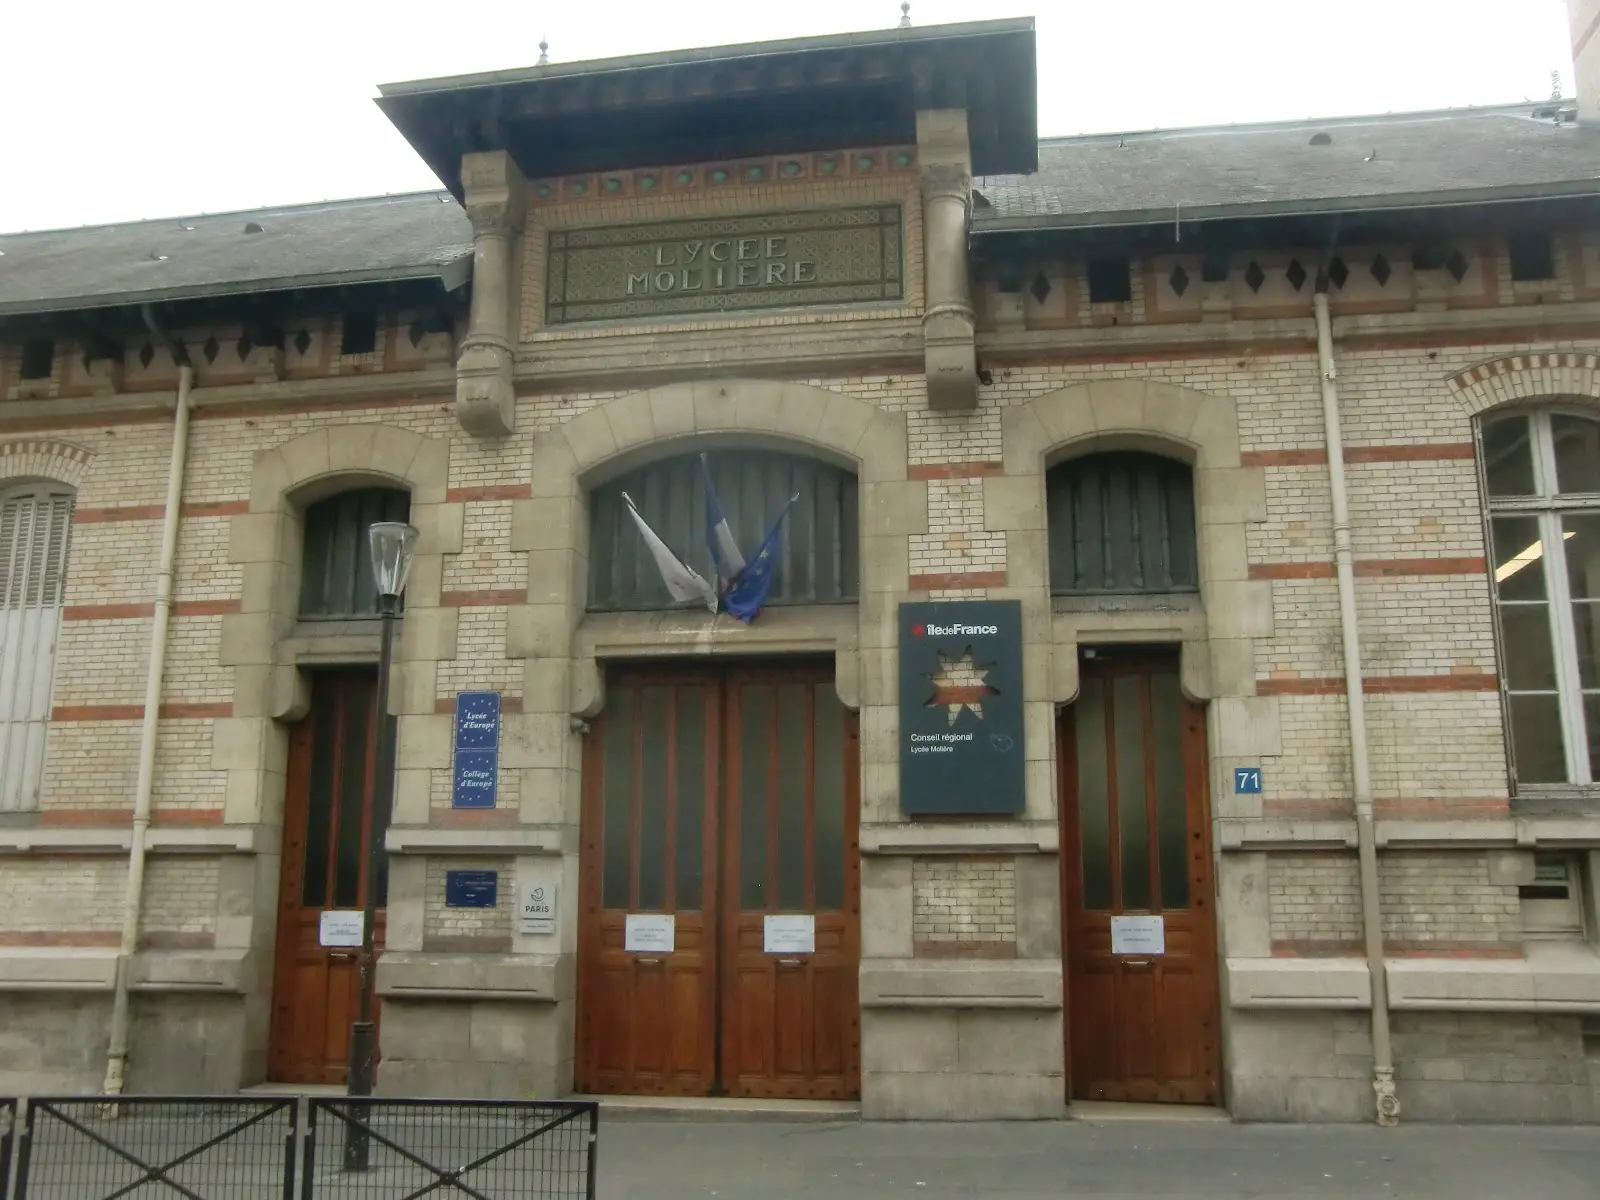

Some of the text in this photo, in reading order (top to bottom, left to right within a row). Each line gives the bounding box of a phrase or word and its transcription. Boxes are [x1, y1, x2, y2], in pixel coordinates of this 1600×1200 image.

[654, 237, 788, 267] LYCEE
[625, 260, 816, 295] MOLIERE
[467, 712, 487, 720] Lycée
[463, 721, 495, 729] d'Europe
[910, 733, 973, 742] Conseil régional
[463, 770, 489, 778] Collège
[460, 780, 492, 788] d'Europe
[1237, 772, 1258, 789] 71
